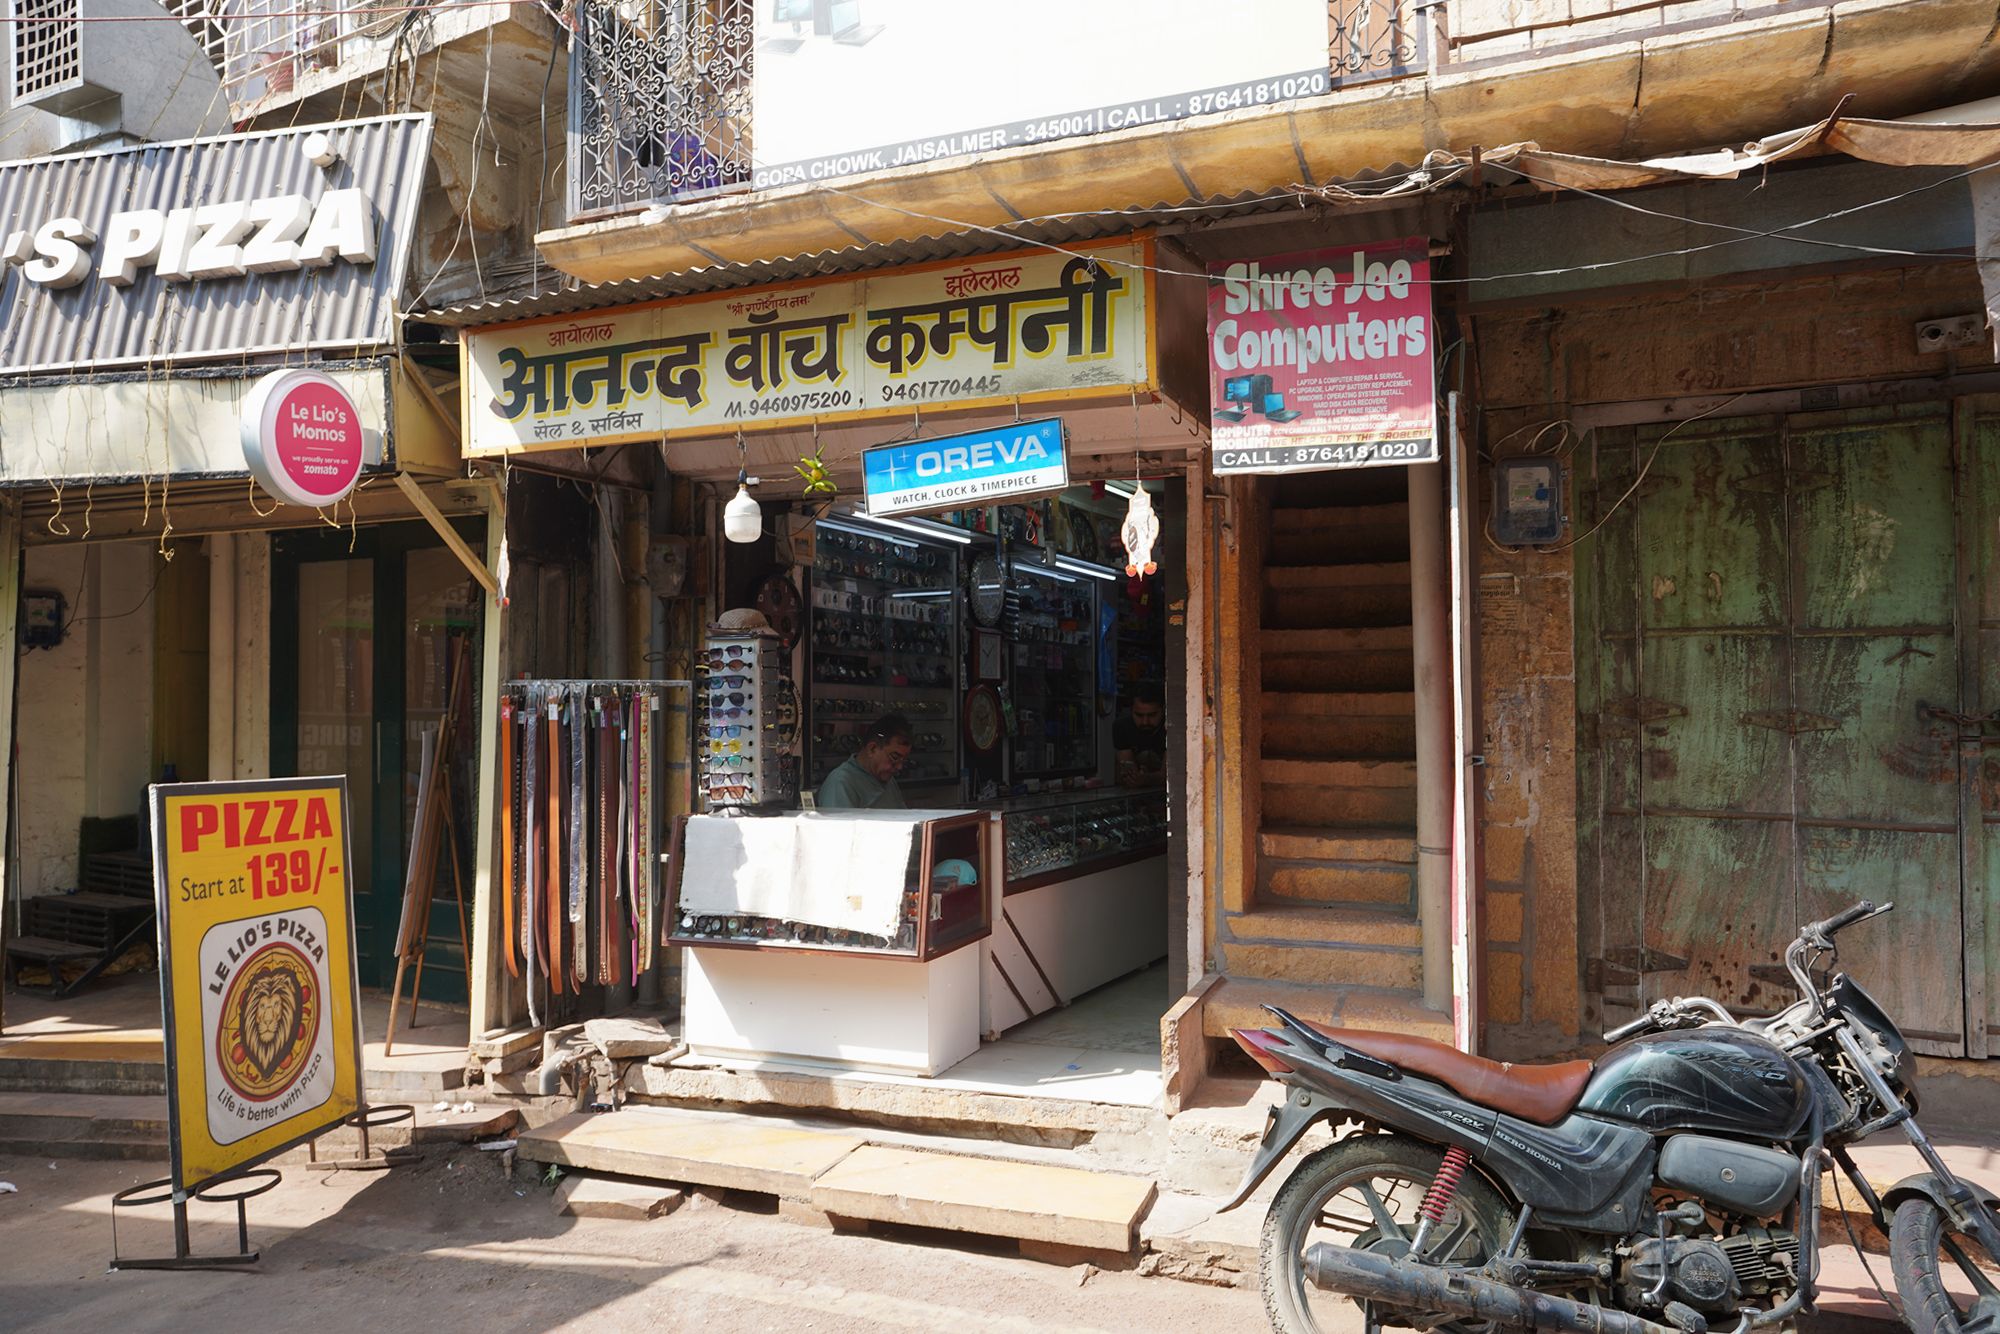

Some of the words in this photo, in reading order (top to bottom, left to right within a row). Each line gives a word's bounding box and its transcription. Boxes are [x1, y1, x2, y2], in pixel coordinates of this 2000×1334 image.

[755, 165, 807, 189] GOPA
[810, 149, 889, 181] CHOWK,
[892, 130, 1008, 166] JAISALMER
[1024, 115, 1095, 142] 345001
[1107, 102, 1169, 128] CALL
[1188, 73, 1325, 115] 8764181020
[100, 188, 375, 286] PIZZA
[1225, 262, 1336, 314] Shree
[1344, 251, 1412, 304] Jee
[488, 331, 718, 421] आनन्द
[724, 309, 854, 393] वॉच
[866, 257, 1129, 378] कम्पनी
[1213, 311, 1426, 374] Computers
[882, 374, 1002, 402] 9461770445
[291, 402, 309, 420] Le
[292, 422, 346, 442] Momos
[534, 421, 566, 439] सेल
[572, 421, 585, 436] &
[589, 410, 644, 433] सर्विस
[915, 434, 1049, 478] OREVA
[1221, 451, 1277, 465] CALL
[1296, 443, 1418, 462] 8764181020
[1336, 433, 1353, 442] FIX
[302, 455, 323, 464] proudly
[303, 464, 339, 475] zomato
[892, 490, 932, 506] WATCH,
[934, 485, 968, 499] CLOCK
[970, 483, 978, 494] &
[981, 474, 1038, 493] TIMEPIECE
[180, 797, 333, 853] PIZZA
[181, 876, 225, 902] Start
[228, 874, 245, 895] at
[246, 847, 339, 900] 139/-
[208, 959, 229, 996] LE
[227, 918, 272, 966] LIO'S
[277, 917, 326, 966] PIZZA
[217, 1086, 236, 1113] Life
[236, 1105, 246, 1120] is
[247, 1103, 280, 1122] better
[279, 1087, 303, 1112] with
[300, 1053, 323, 1091] Pizza
[1495, 1130, 1526, 1150] HERO
[1525, 1147, 1563, 1171] HONDA
